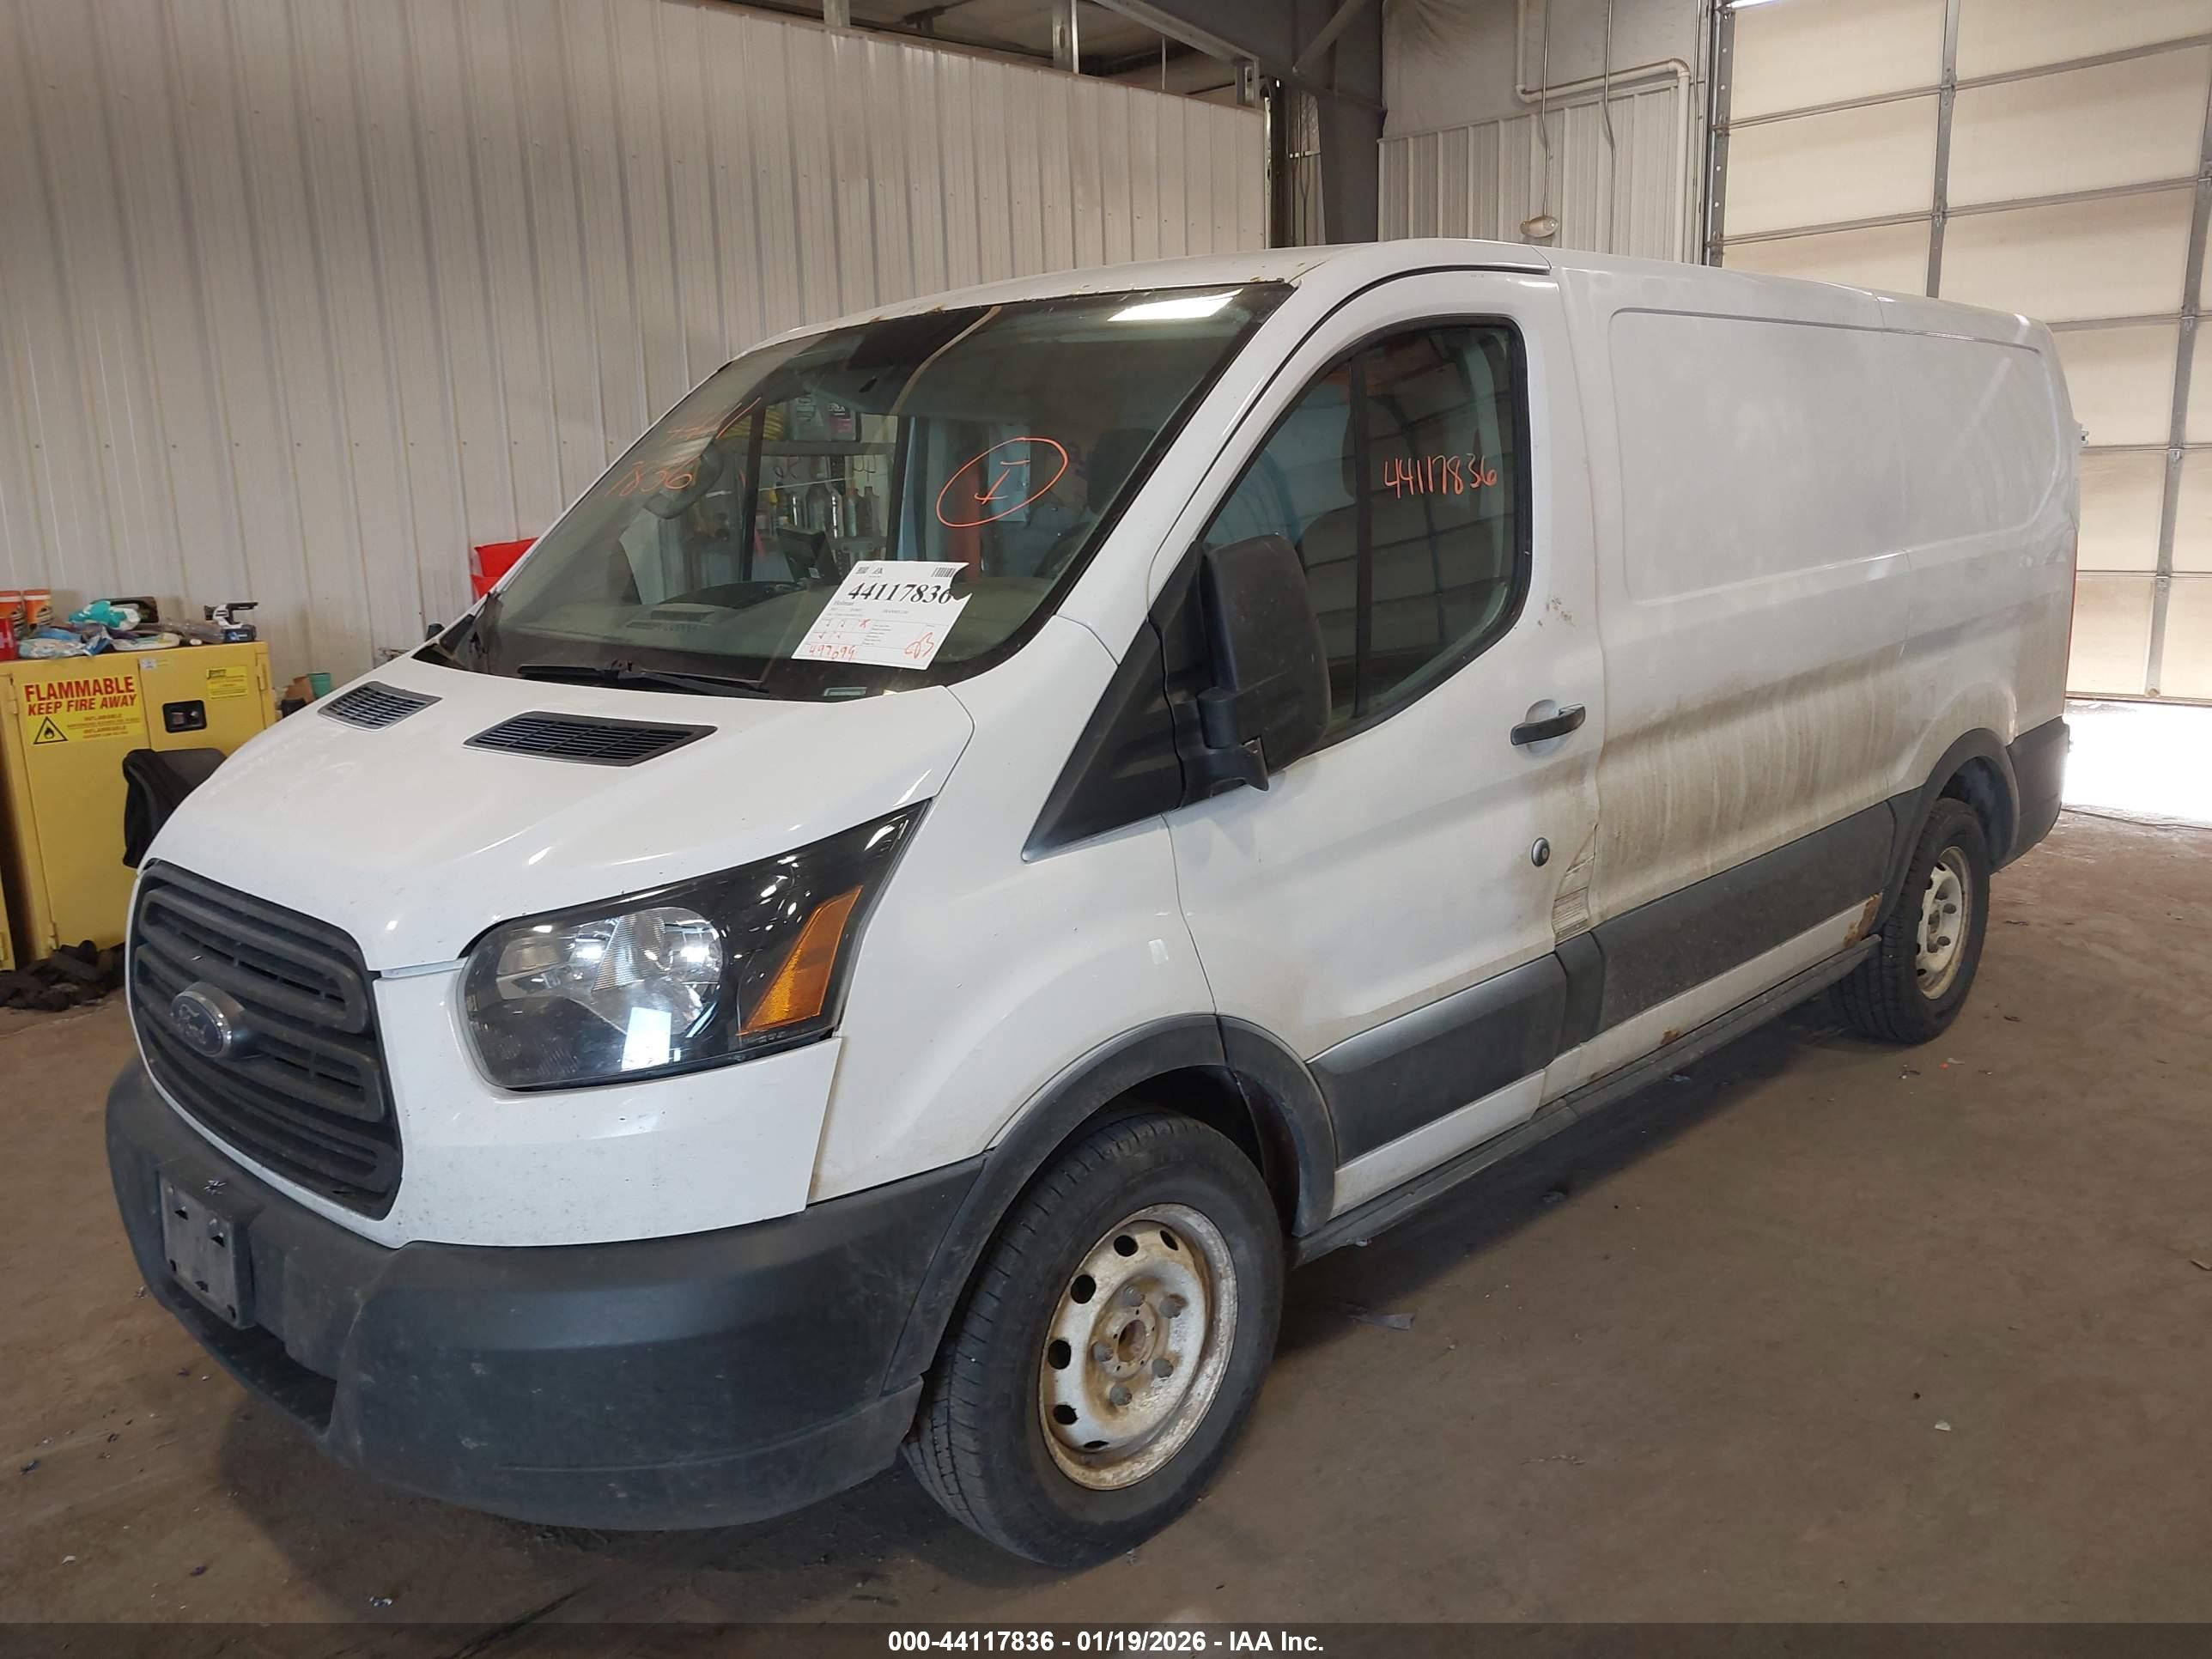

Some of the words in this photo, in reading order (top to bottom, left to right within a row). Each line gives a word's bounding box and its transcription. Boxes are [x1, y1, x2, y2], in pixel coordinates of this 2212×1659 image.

[1383, 453, 1498, 499] 44117836
[848, 582, 952, 604] 44117836
[24, 676, 135, 702] FLAMMABLE
[27, 700, 63, 716] KEEP
[66, 697, 96, 712] FIRE
[100, 694, 137, 709] AWAY
